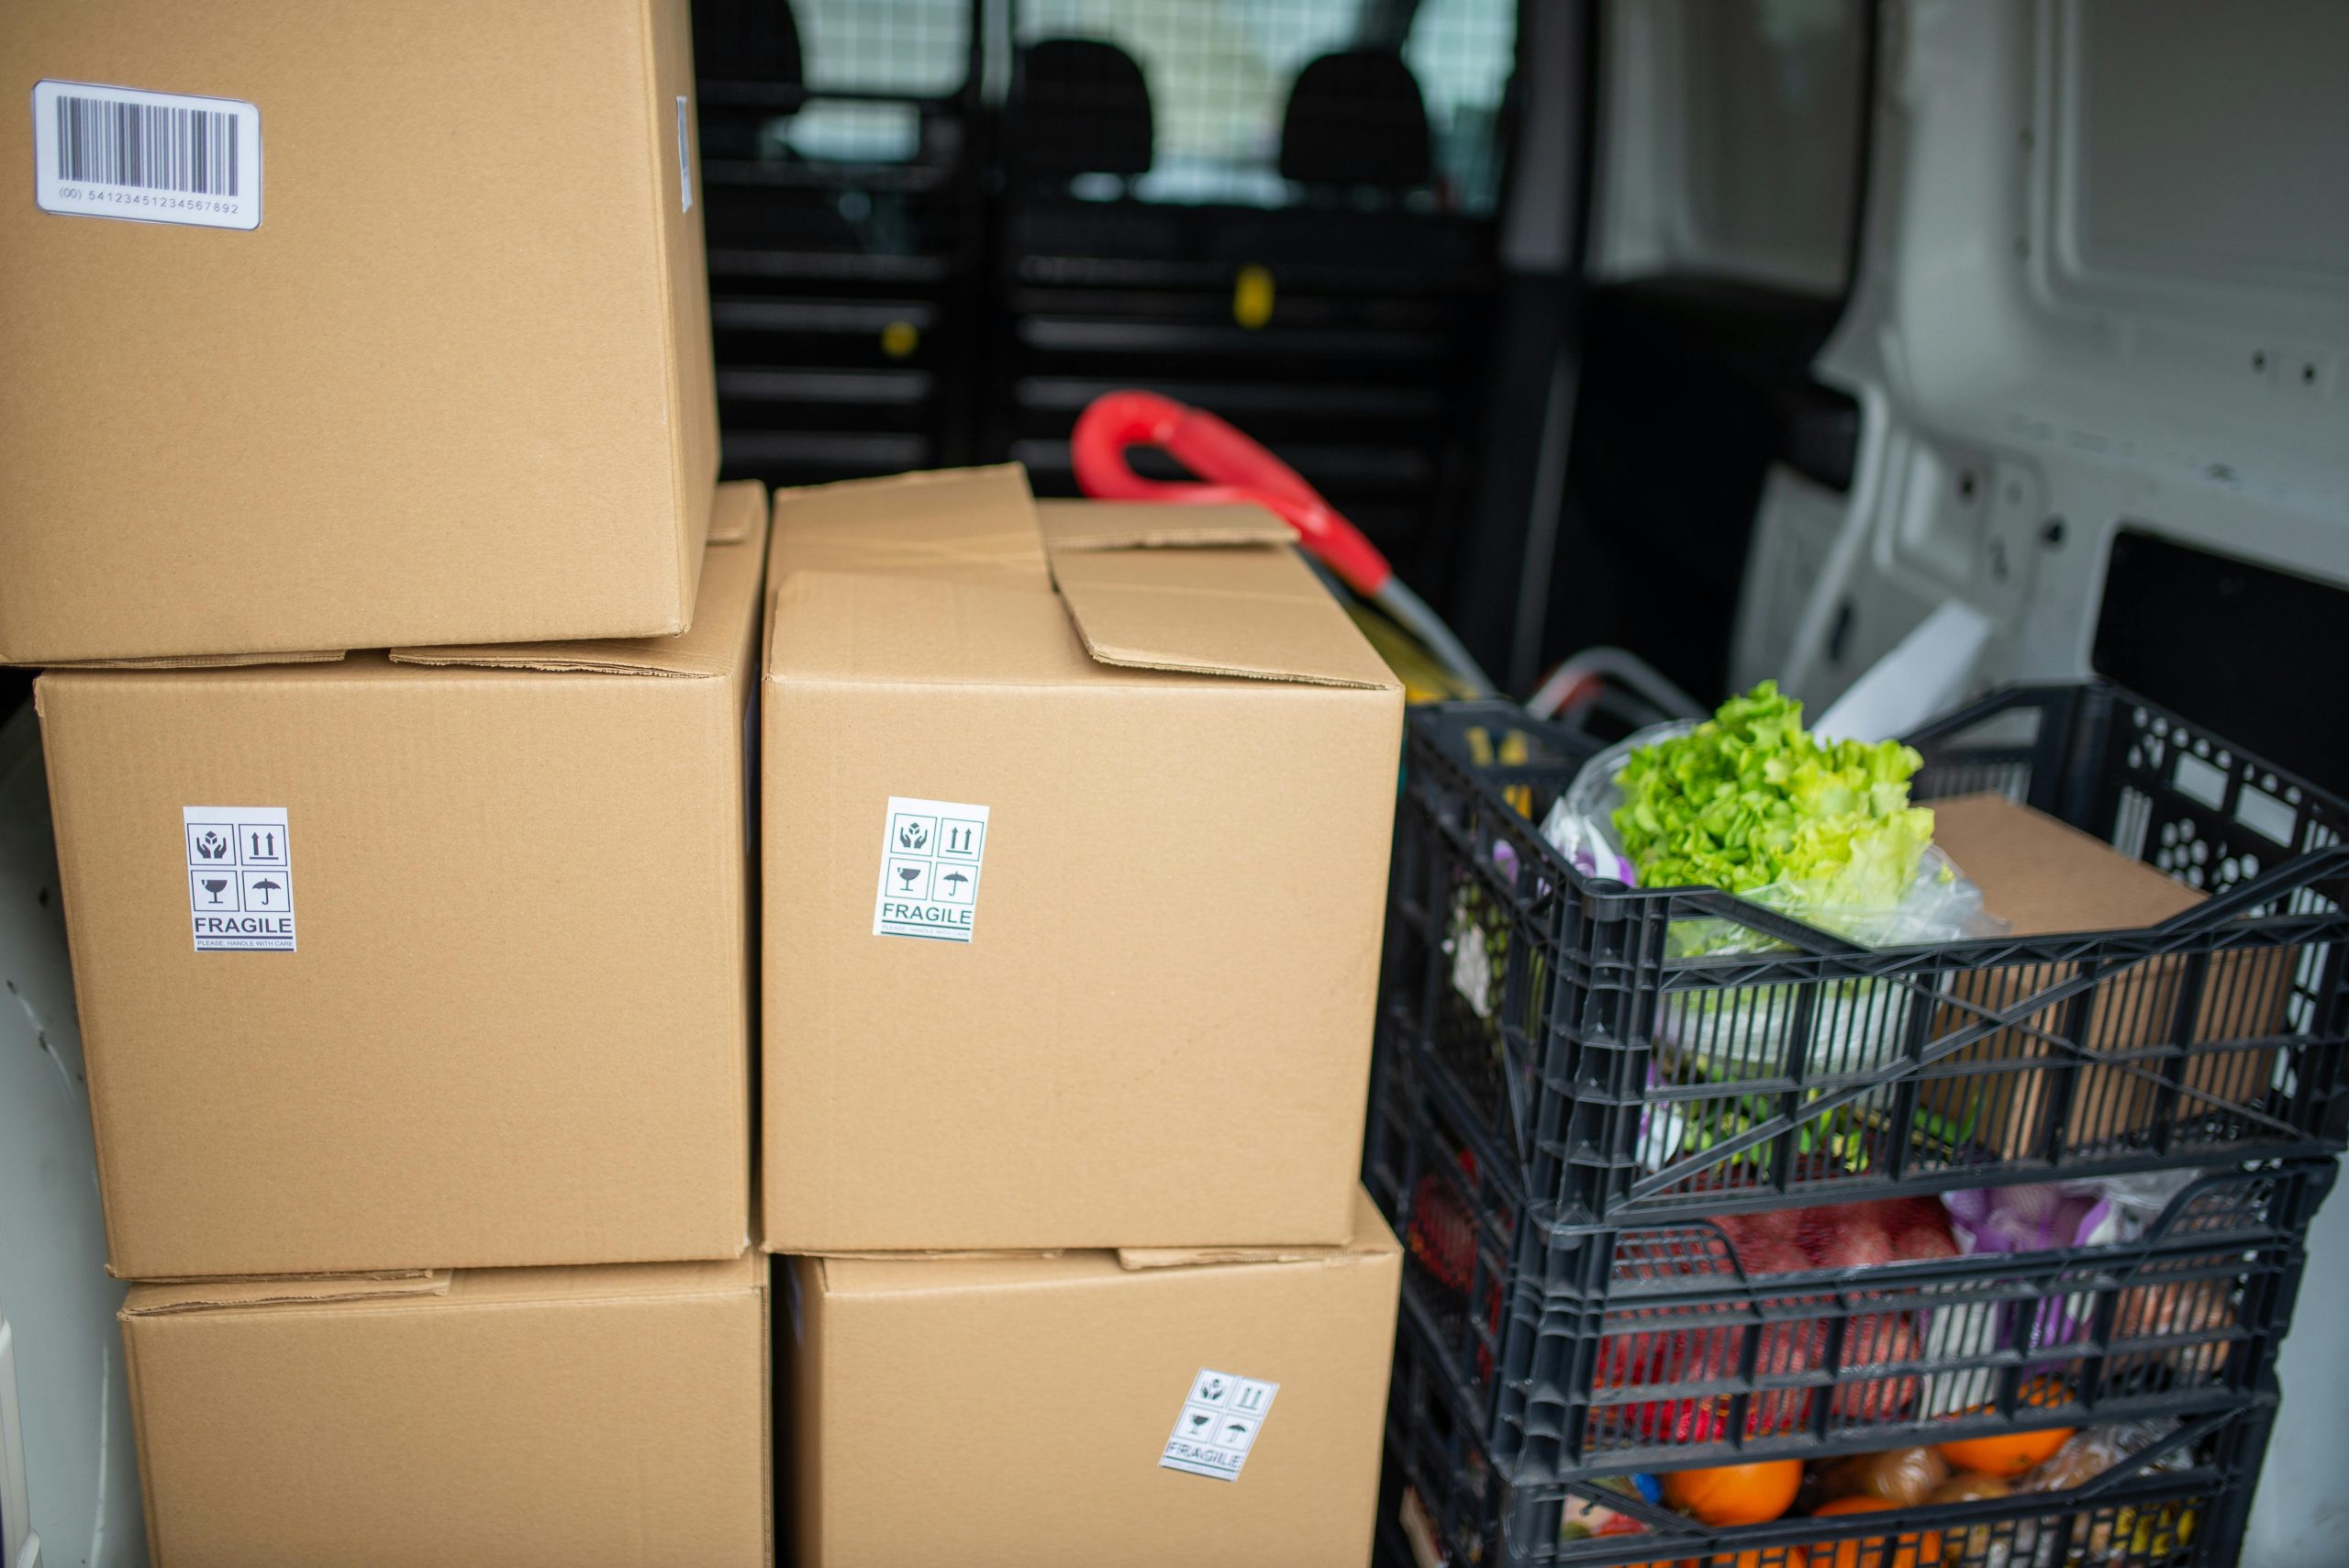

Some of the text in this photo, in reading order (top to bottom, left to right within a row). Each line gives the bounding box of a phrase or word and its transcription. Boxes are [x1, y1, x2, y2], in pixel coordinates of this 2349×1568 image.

[59, 187, 239, 214] (00) 54123451234567892
[195, 917, 293, 933] FRAGILE
[883, 903, 973, 925] FRAGILE
[1164, 1441, 1241, 1468] FRAGILE
